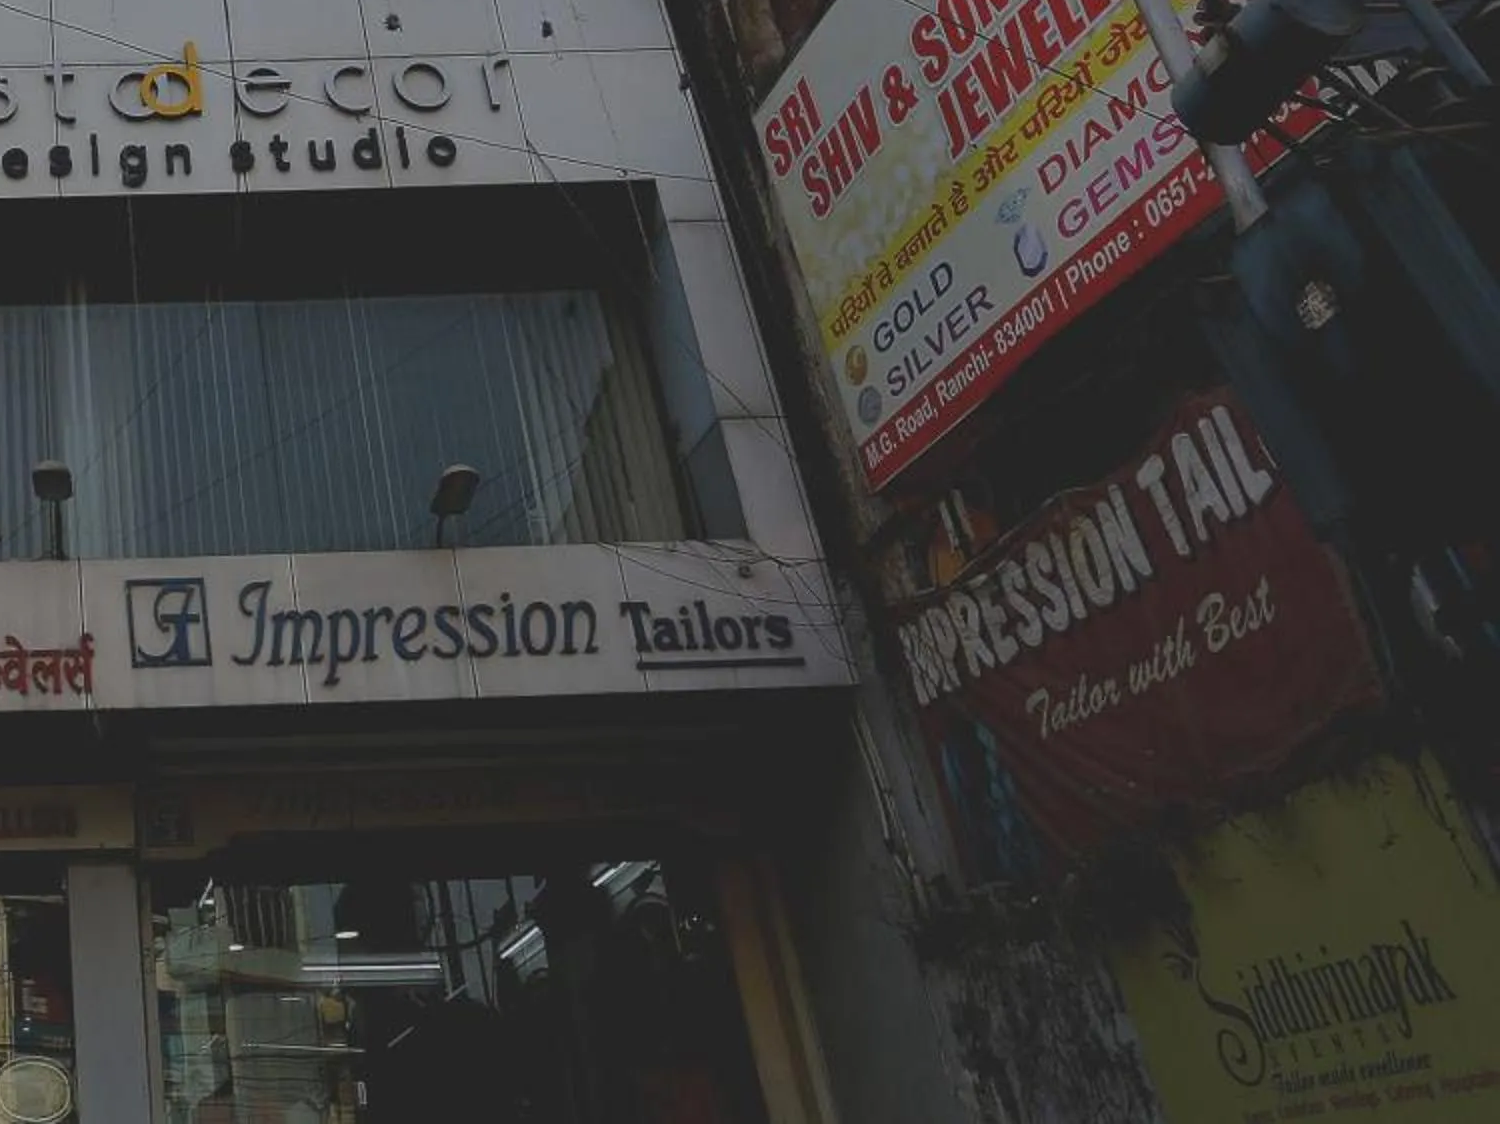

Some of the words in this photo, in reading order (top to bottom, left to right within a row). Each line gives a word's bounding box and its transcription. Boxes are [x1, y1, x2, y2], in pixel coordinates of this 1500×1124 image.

[230, 125, 458, 172] studio
[765, 77, 825, 178] SRI
[802, 87, 882, 221] SHIV
[878, 64, 918, 126] &
[1056, 112, 1187, 240] GEMS
[872, 261, 955, 354] GOLD
[887, 286, 994, 397] SILVER
[896, 394, 937, 440] Road,
[993, 292, 1055, 357] 834001
[1065, 230, 1132, 302] Phone
[231, 579, 599, 686] Impression
[620, 601, 794, 654] Tailors
[1025, 674, 1122, 739] Tailor
[1129, 616, 1197, 693] with
[1199, 574, 1276, 655] Best
